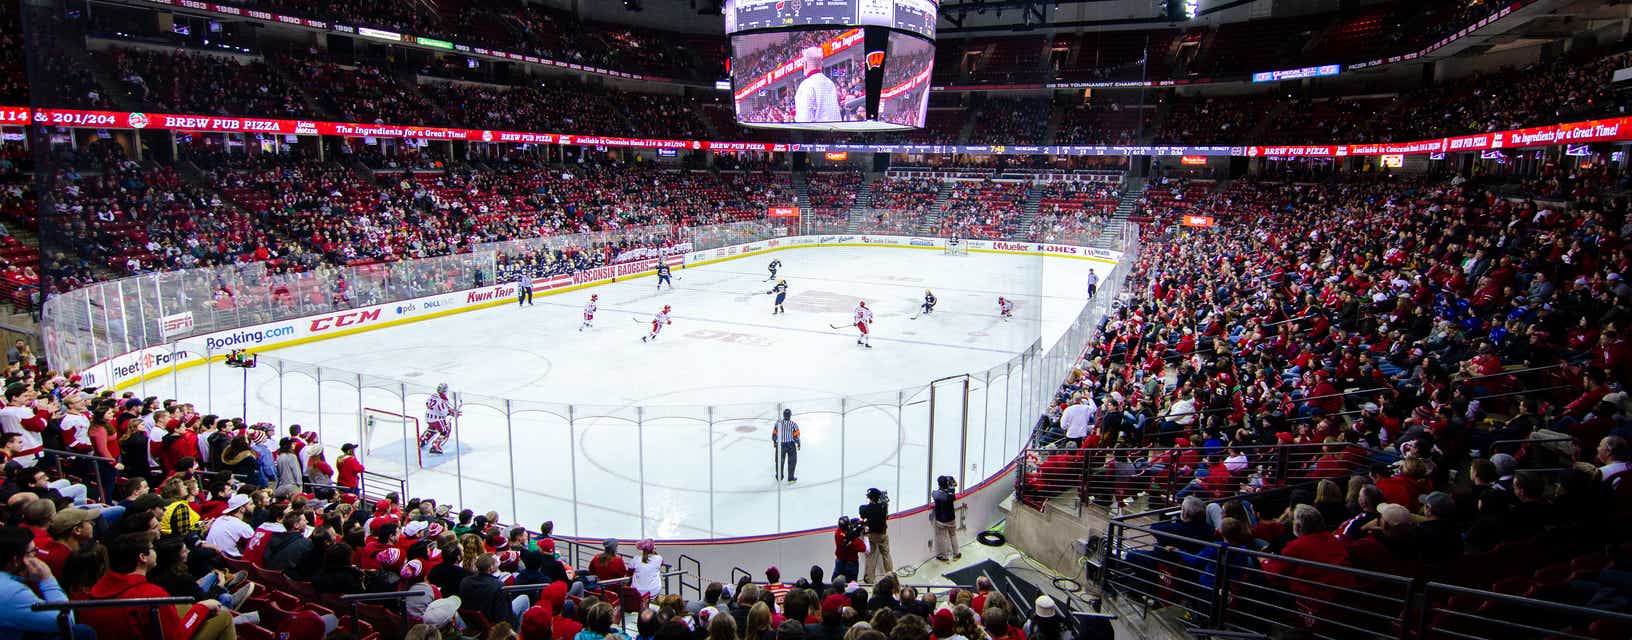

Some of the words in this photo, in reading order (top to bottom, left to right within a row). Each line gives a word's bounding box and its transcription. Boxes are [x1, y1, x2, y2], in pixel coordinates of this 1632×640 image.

[0, 110, 28, 120] 114
[34, 112, 48, 122] &
[53, 113, 115, 124] 201/204
[165, 117, 208, 128] BREW
[213, 119, 240, 129] PUB
[244, 120, 280, 131] PIZZA
[336, 125, 352, 133] The
[355, 126, 402, 136] Ingredients
[402, 128, 416, 137] for
[1512, 133, 1521, 143] The
[1522, 130, 1554, 145] Ingredients
[1554, 128, 1565, 143] for
[1566, 130, 1571, 139] a
[1573, 126, 1593, 138] Great
[1595, 123, 1619, 136] Time!
[1037, 245, 1077, 253] KOHL'S
[573, 266, 615, 285] WISCONSIN
[618, 260, 649, 276] BADGERS
[403, 304, 416, 315] pds
[164, 316, 193, 331] ESPN
[309, 308, 382, 332] CCM
[206, 325, 294, 350] Booking.com
[114, 361, 140, 379] Fleet
